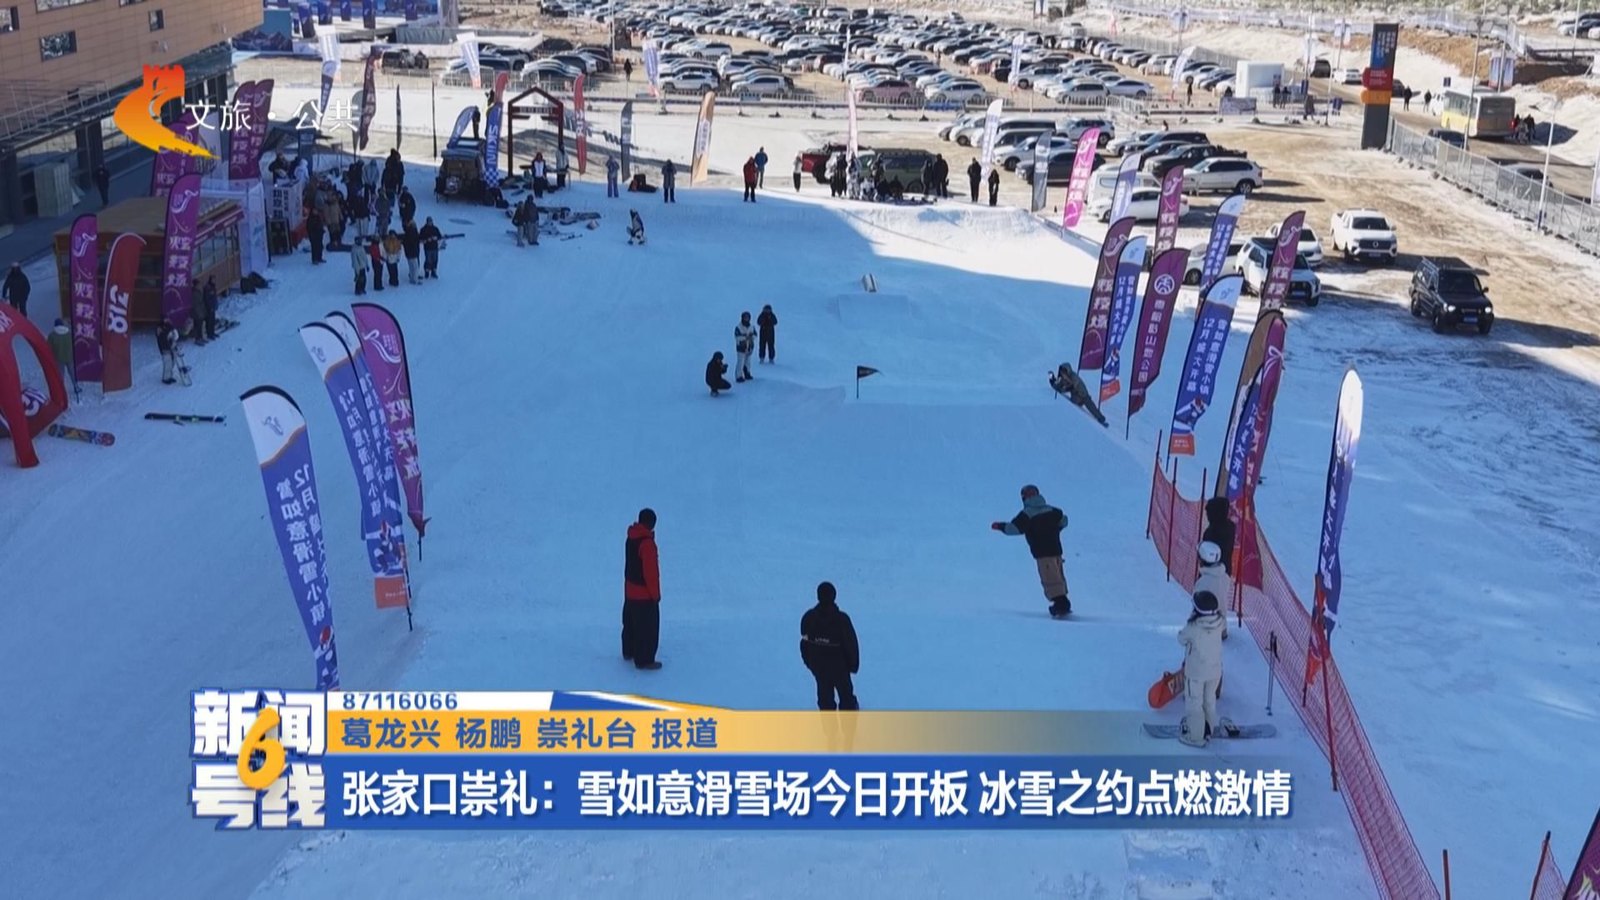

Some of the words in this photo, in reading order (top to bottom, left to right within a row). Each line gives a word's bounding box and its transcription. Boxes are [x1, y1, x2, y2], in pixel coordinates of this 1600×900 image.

[1199, 319, 1228, 396] 雪如意滑雪小镇
